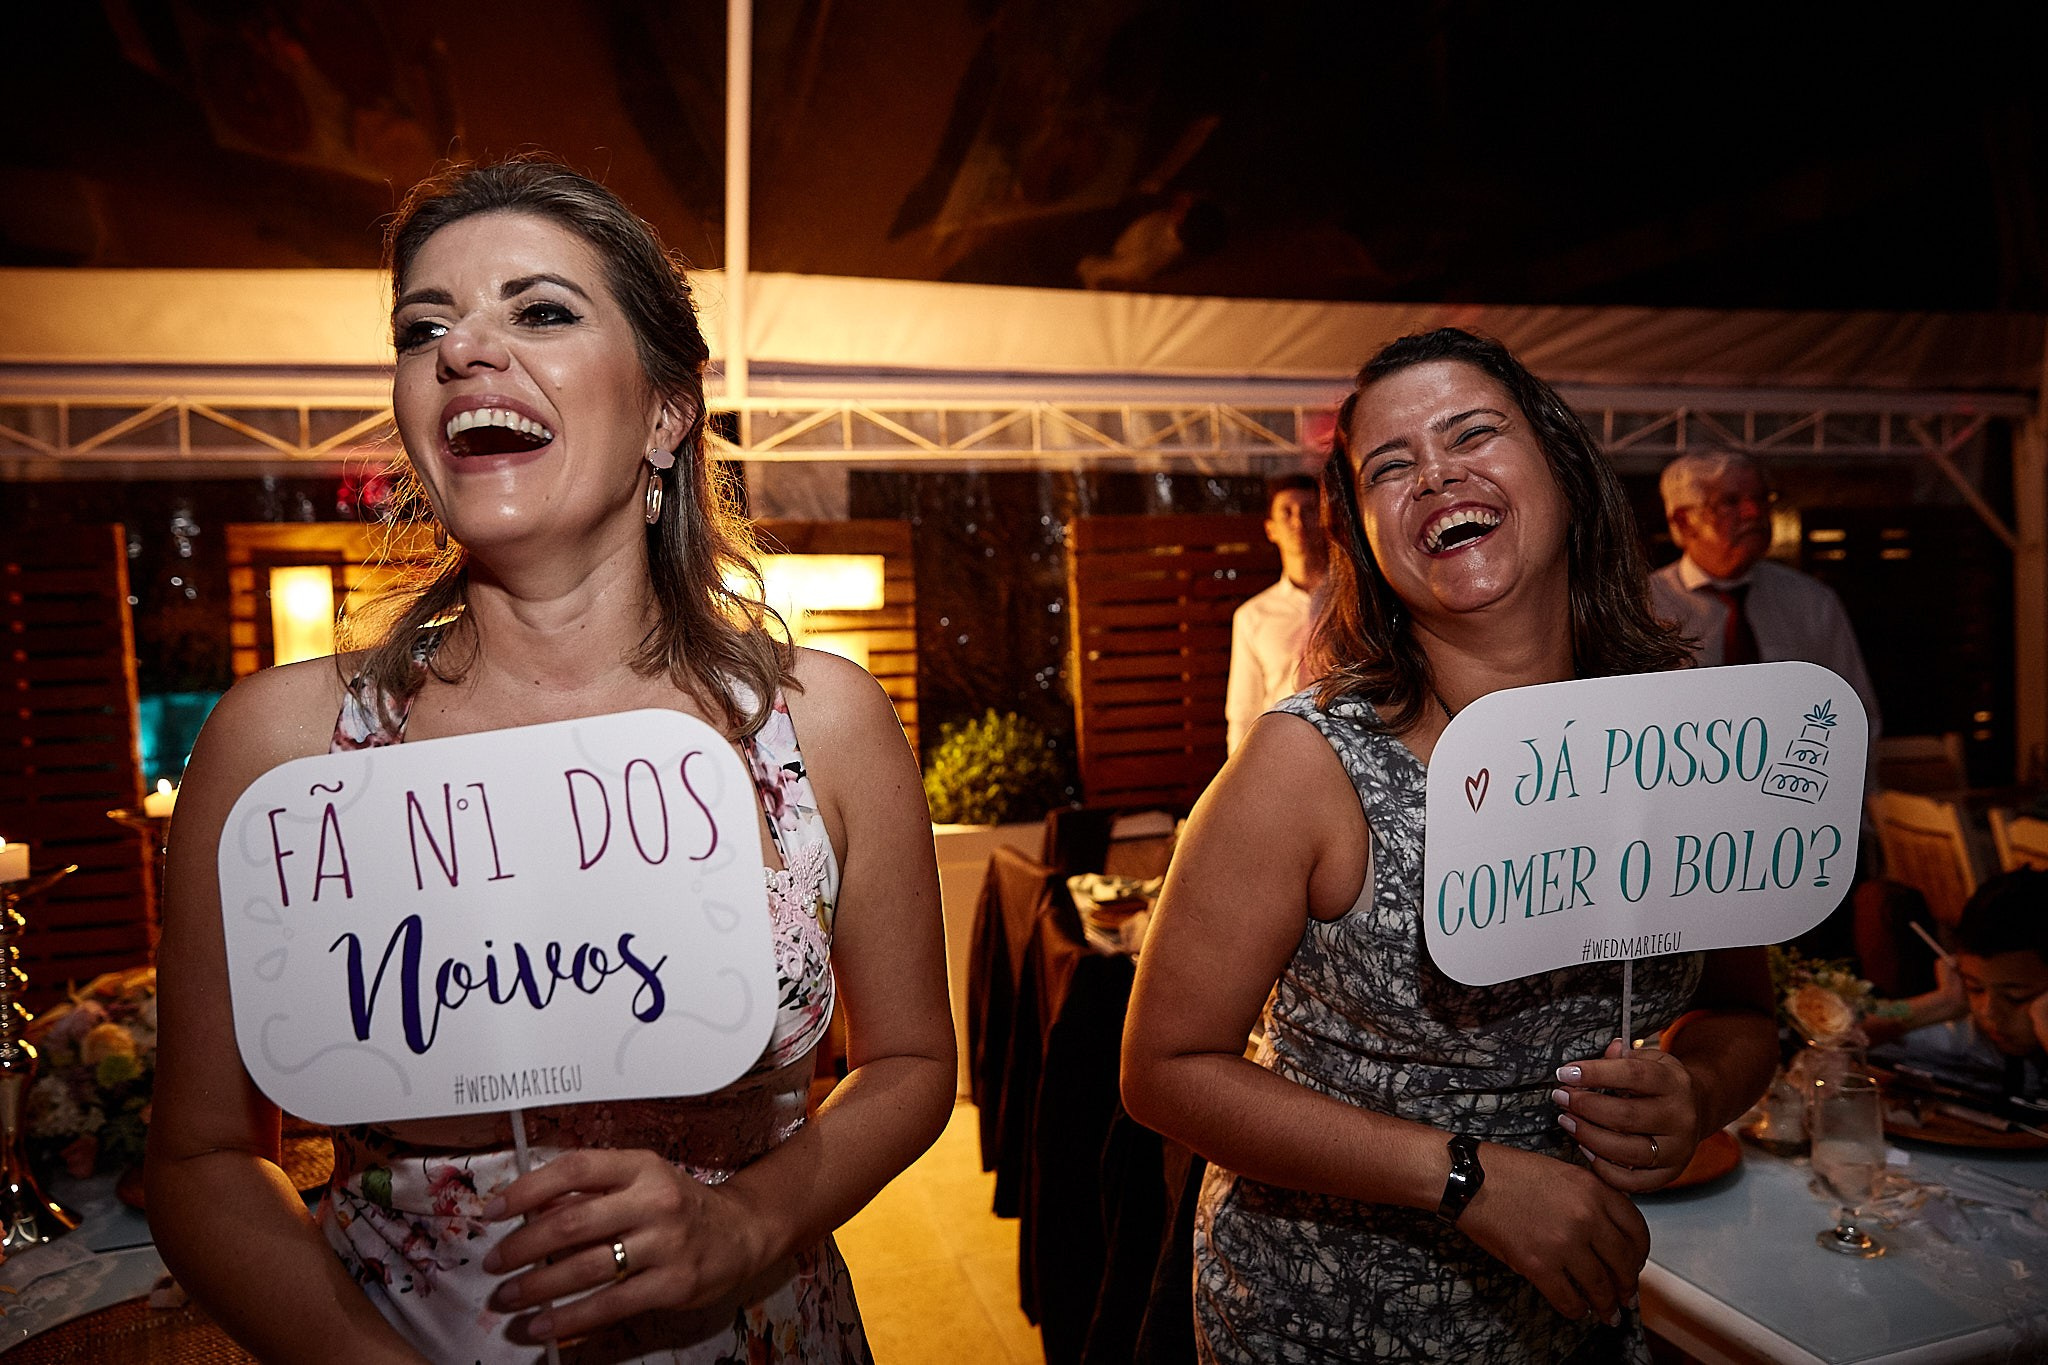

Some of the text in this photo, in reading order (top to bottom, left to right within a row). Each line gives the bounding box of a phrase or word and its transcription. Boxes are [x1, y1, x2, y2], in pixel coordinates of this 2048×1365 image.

[1514, 716, 1769, 807] JÁ POSSO
[267, 780, 354, 908] FÃ
[563, 750, 719, 871] DOS
[1437, 824, 1843, 937] COMER O BOLO?
[328, 913, 669, 1055] Noivos
[1581, 930, 1683, 962] #WEDMARIEGU
[453, 1064, 584, 1106] #WEDMARIEGU
